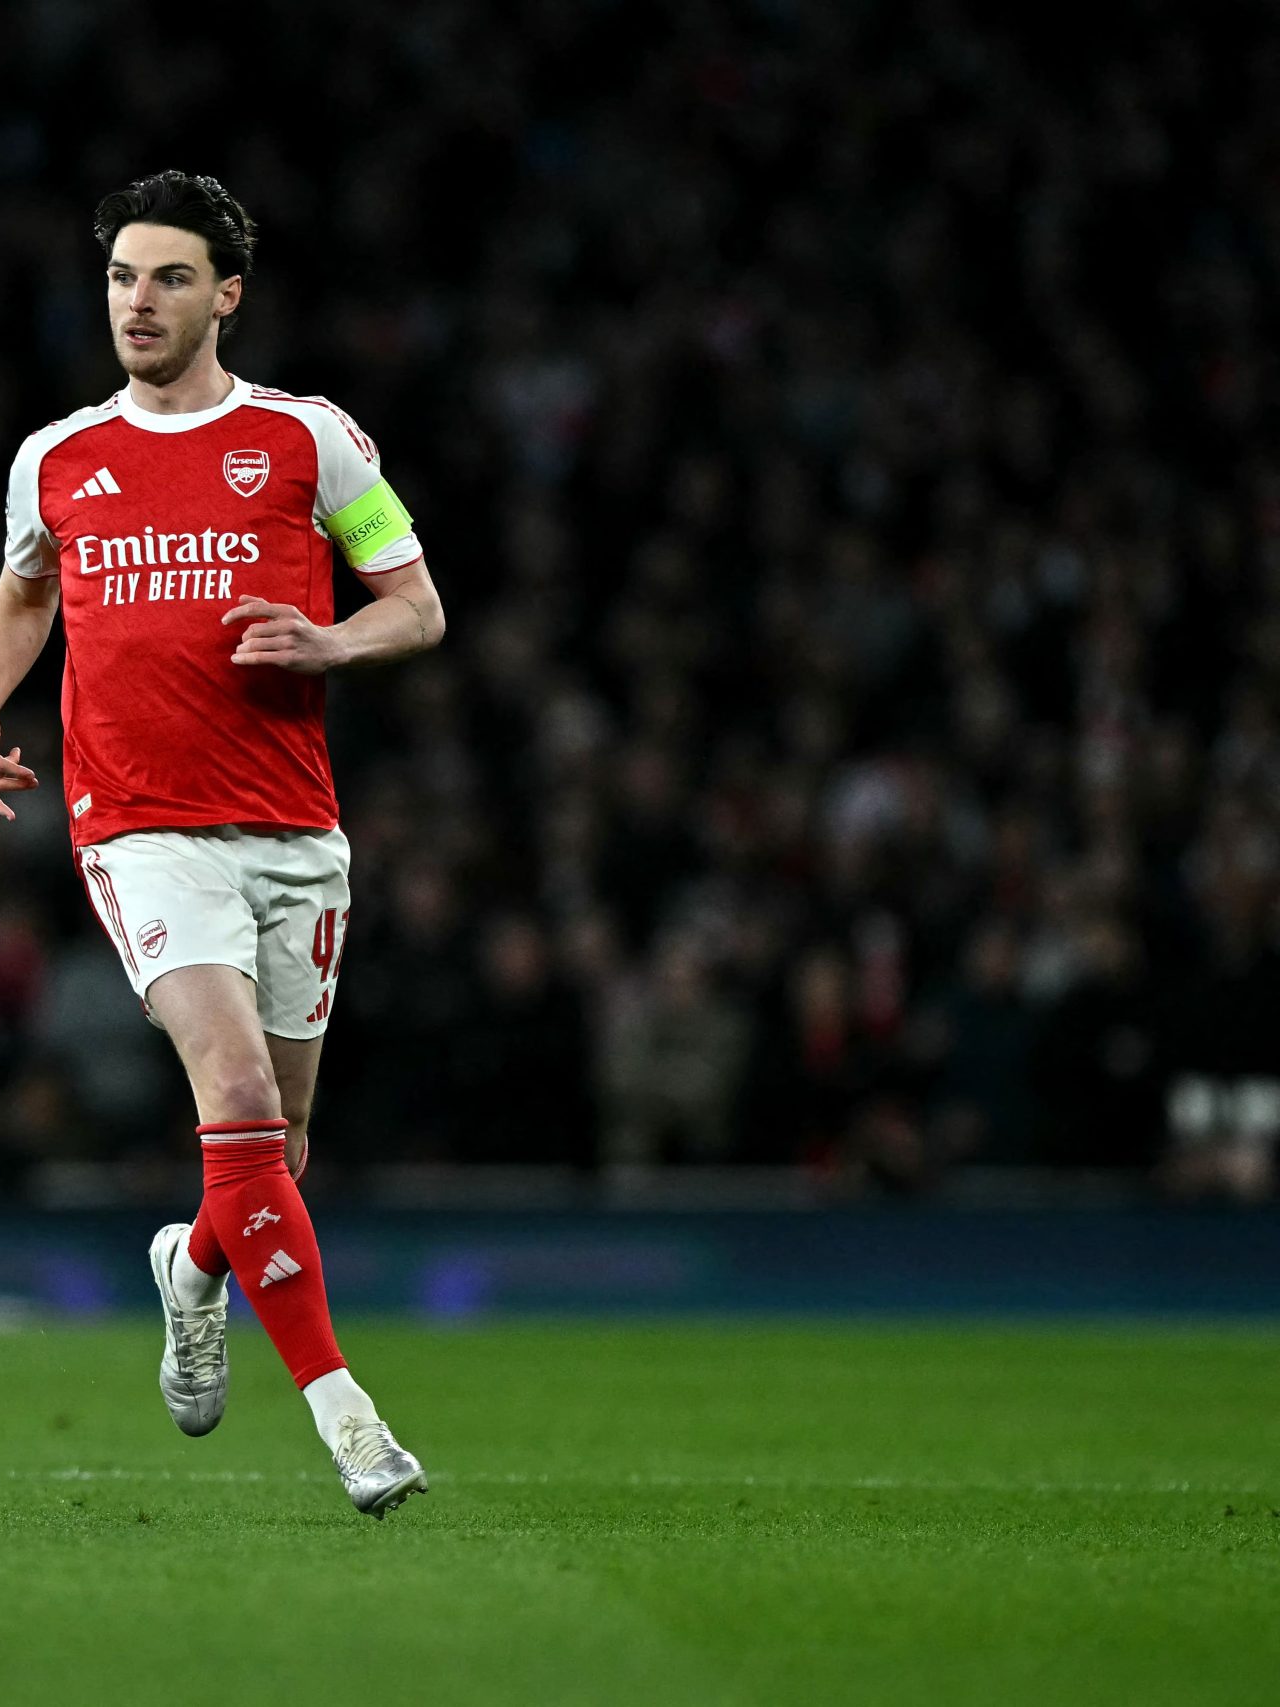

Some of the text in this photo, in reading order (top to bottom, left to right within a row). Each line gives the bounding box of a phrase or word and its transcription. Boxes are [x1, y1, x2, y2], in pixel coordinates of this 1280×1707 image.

[230, 457, 264, 465] Arsenal
[345, 511, 388, 545] RESPECT
[75, 526, 260, 574] Emirates
[103, 569, 233, 606] FLY BETTER
